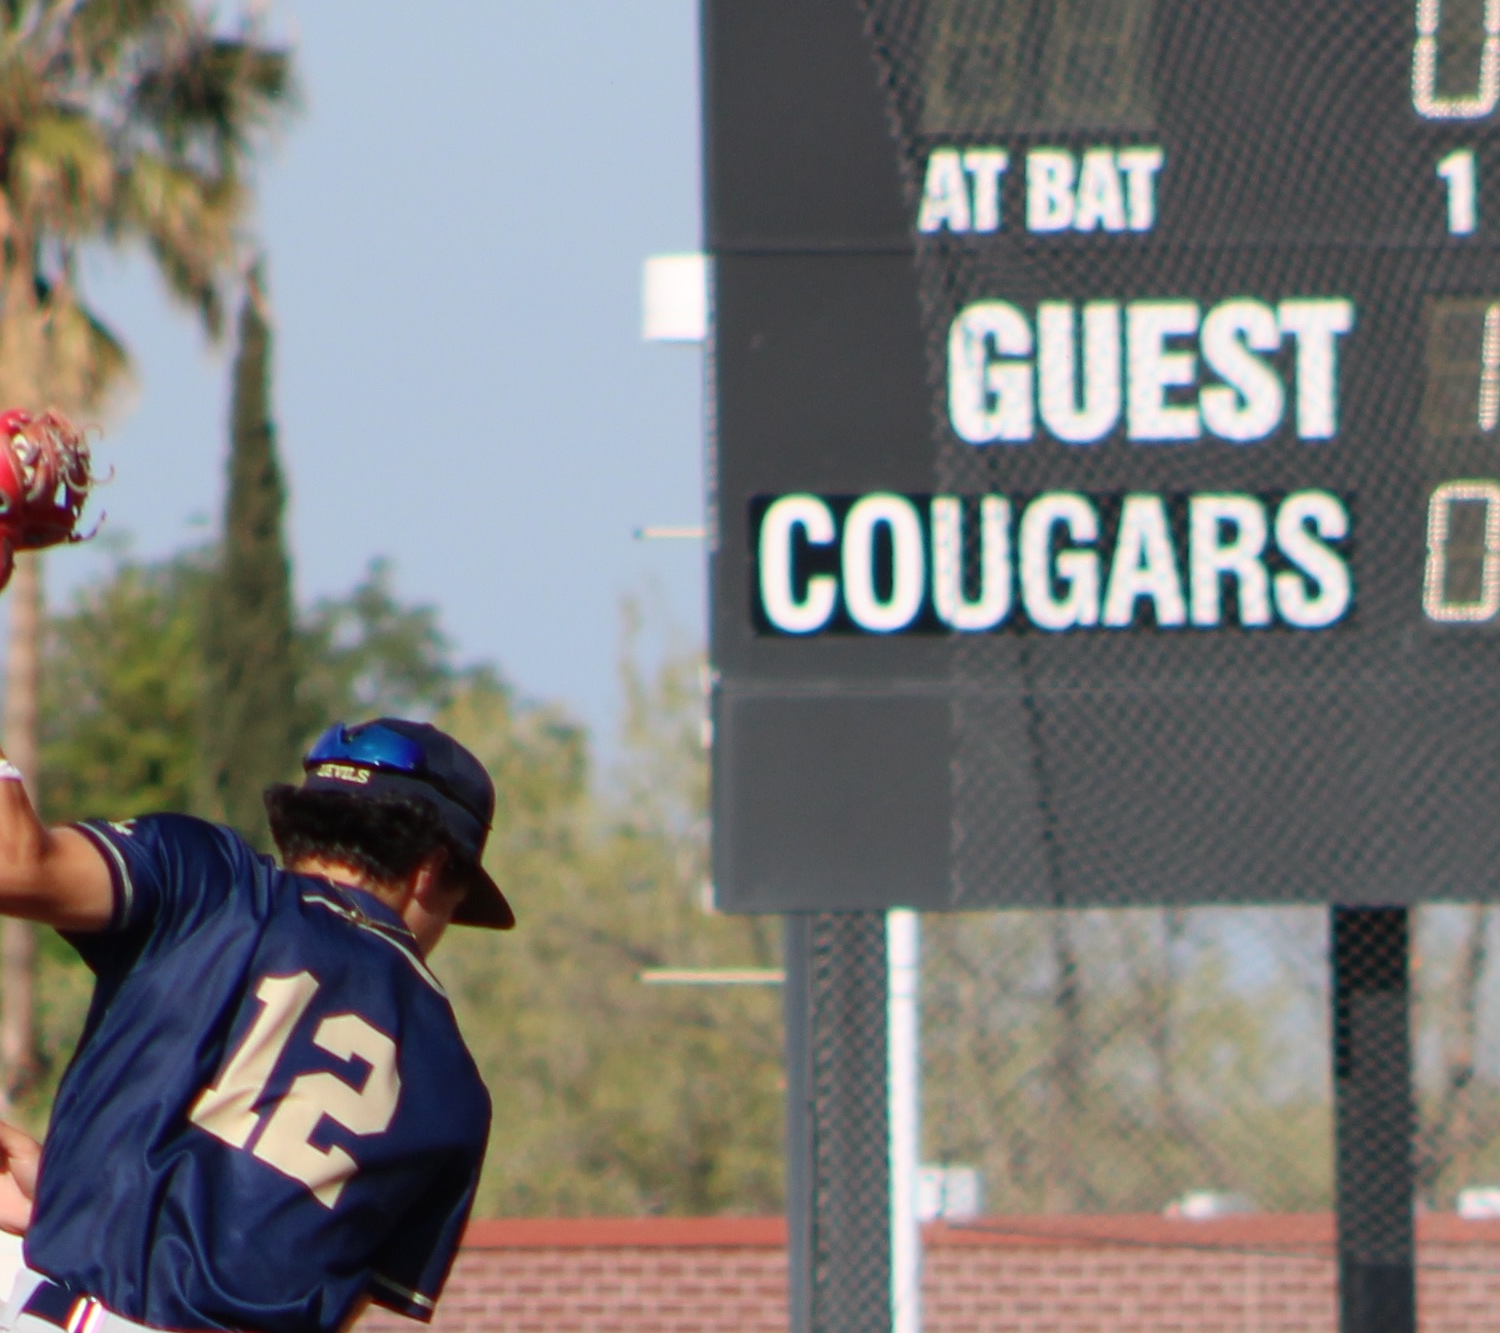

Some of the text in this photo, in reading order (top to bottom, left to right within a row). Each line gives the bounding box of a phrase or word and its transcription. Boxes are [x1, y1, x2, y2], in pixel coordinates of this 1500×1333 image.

[917, 148, 1009, 234] AT
[1025, 147, 1164, 233] BAT
[1436, 150, 1476, 235] 1
[947, 298, 1354, 445] GUEST
[759, 491, 1351, 634] COUGARS
[189, 970, 400, 1209] 12
